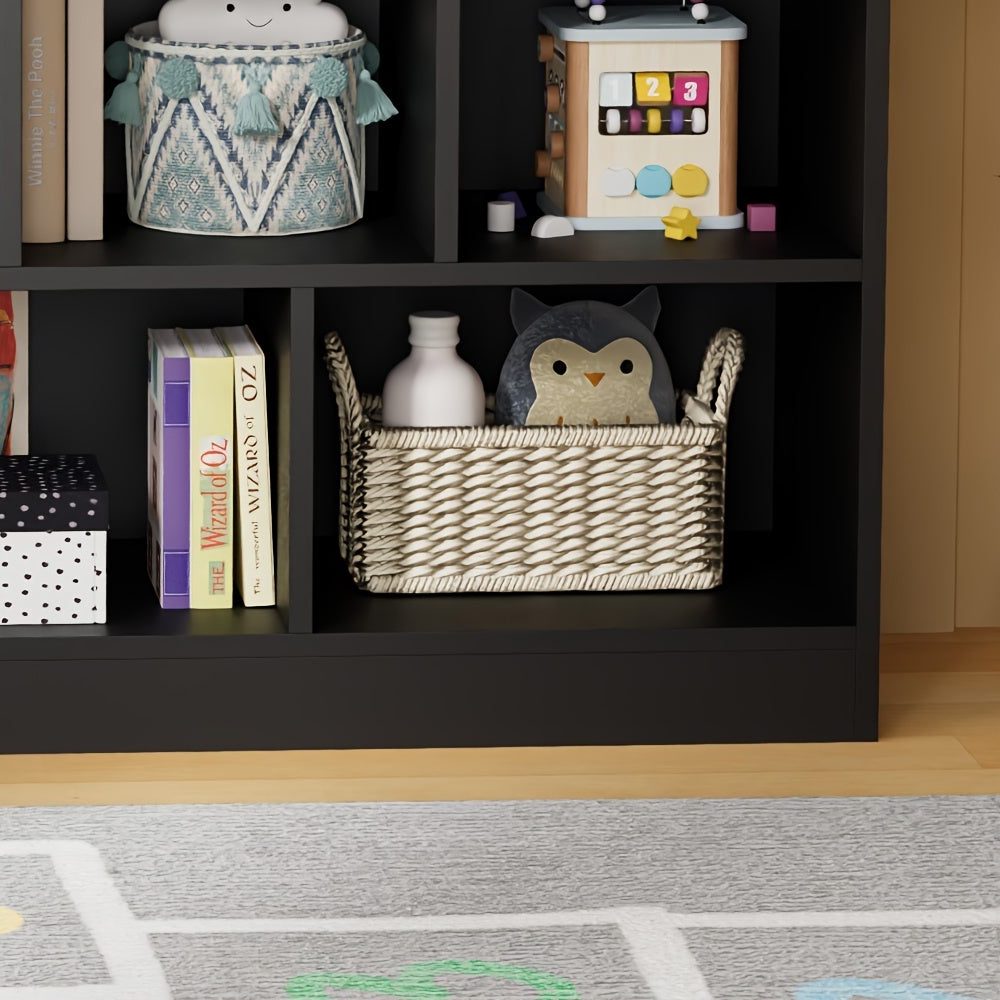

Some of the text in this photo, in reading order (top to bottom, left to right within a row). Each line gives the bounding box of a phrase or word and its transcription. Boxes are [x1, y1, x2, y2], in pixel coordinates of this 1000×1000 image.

[646, 77, 659, 97] 2
[683, 81, 698, 101] 3
[27, 36, 43, 187] Winnie The Pooh
[241, 365, 258, 401] OZ
[244, 415, 254, 429] of
[243, 435, 260, 514] WIZARD
[200, 439, 228, 595] THE Wizard of Oz
